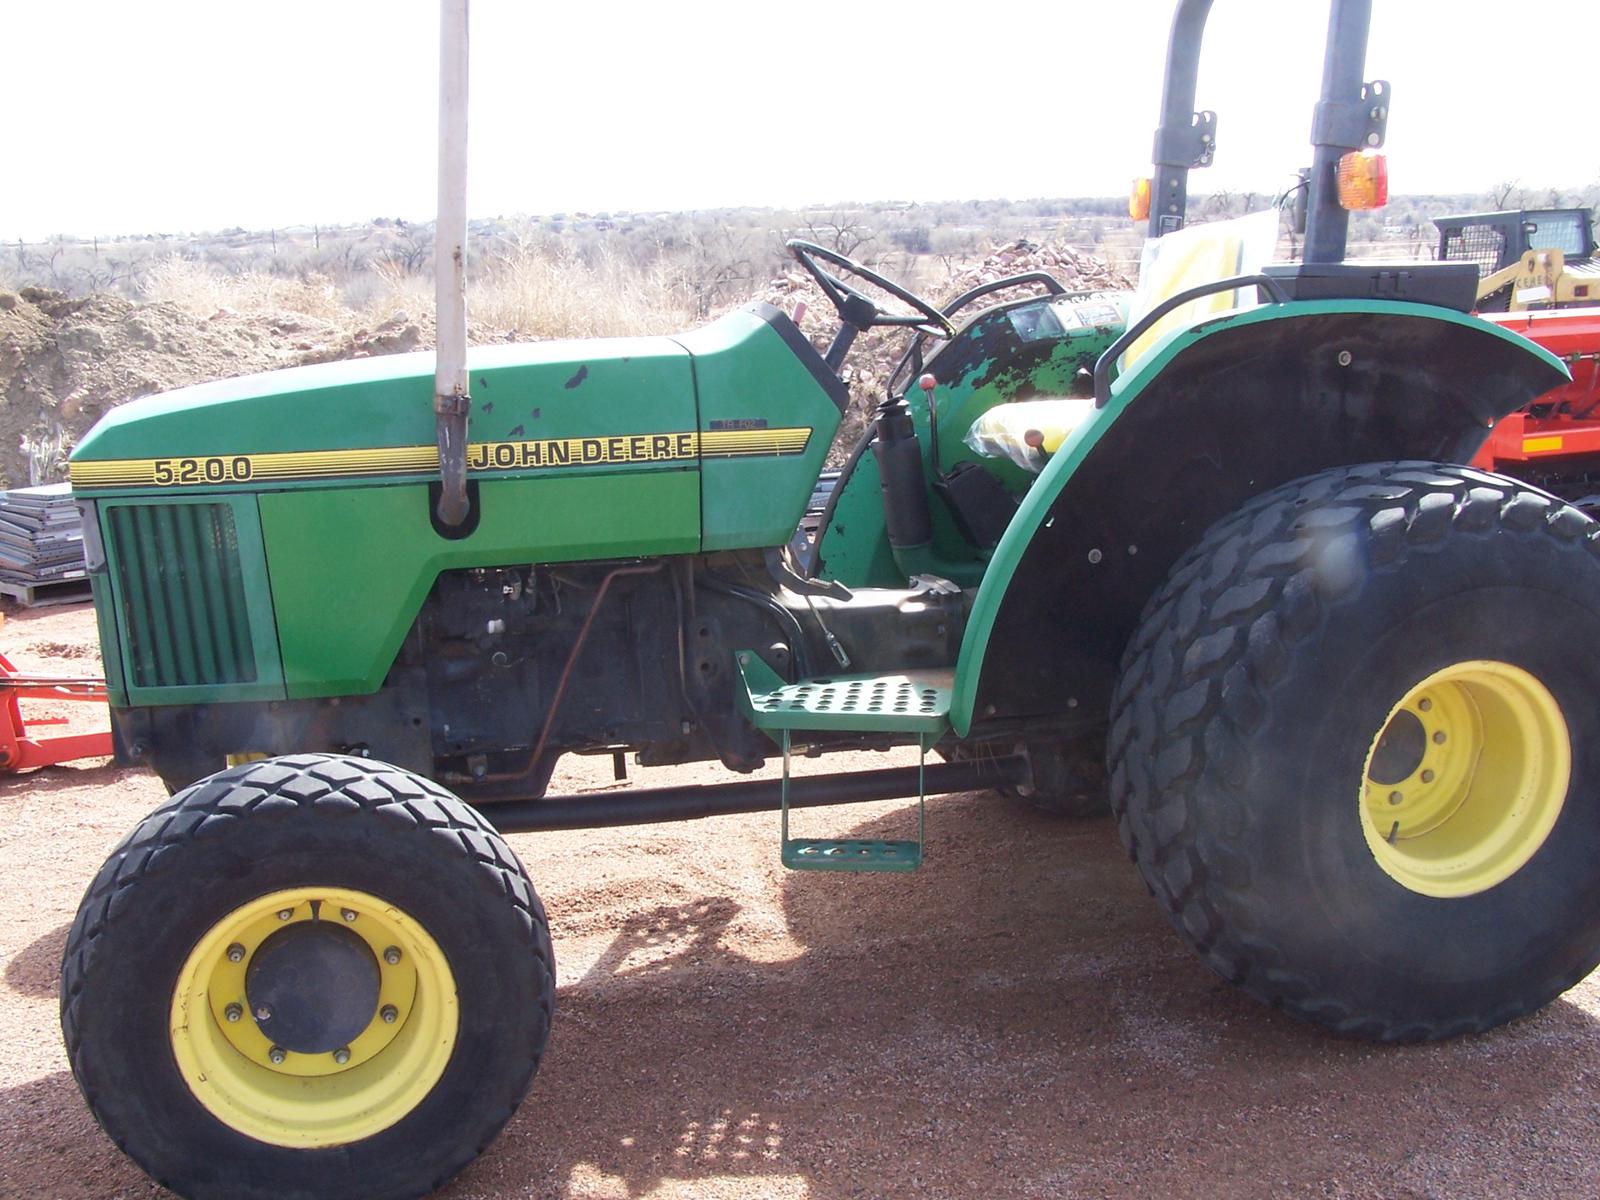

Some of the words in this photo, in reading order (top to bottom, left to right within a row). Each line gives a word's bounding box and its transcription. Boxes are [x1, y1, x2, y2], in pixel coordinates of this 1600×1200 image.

[472, 440, 570, 468] JOHN
[581, 434, 694, 463] DEERE
[153, 457, 252, 485] 5200
